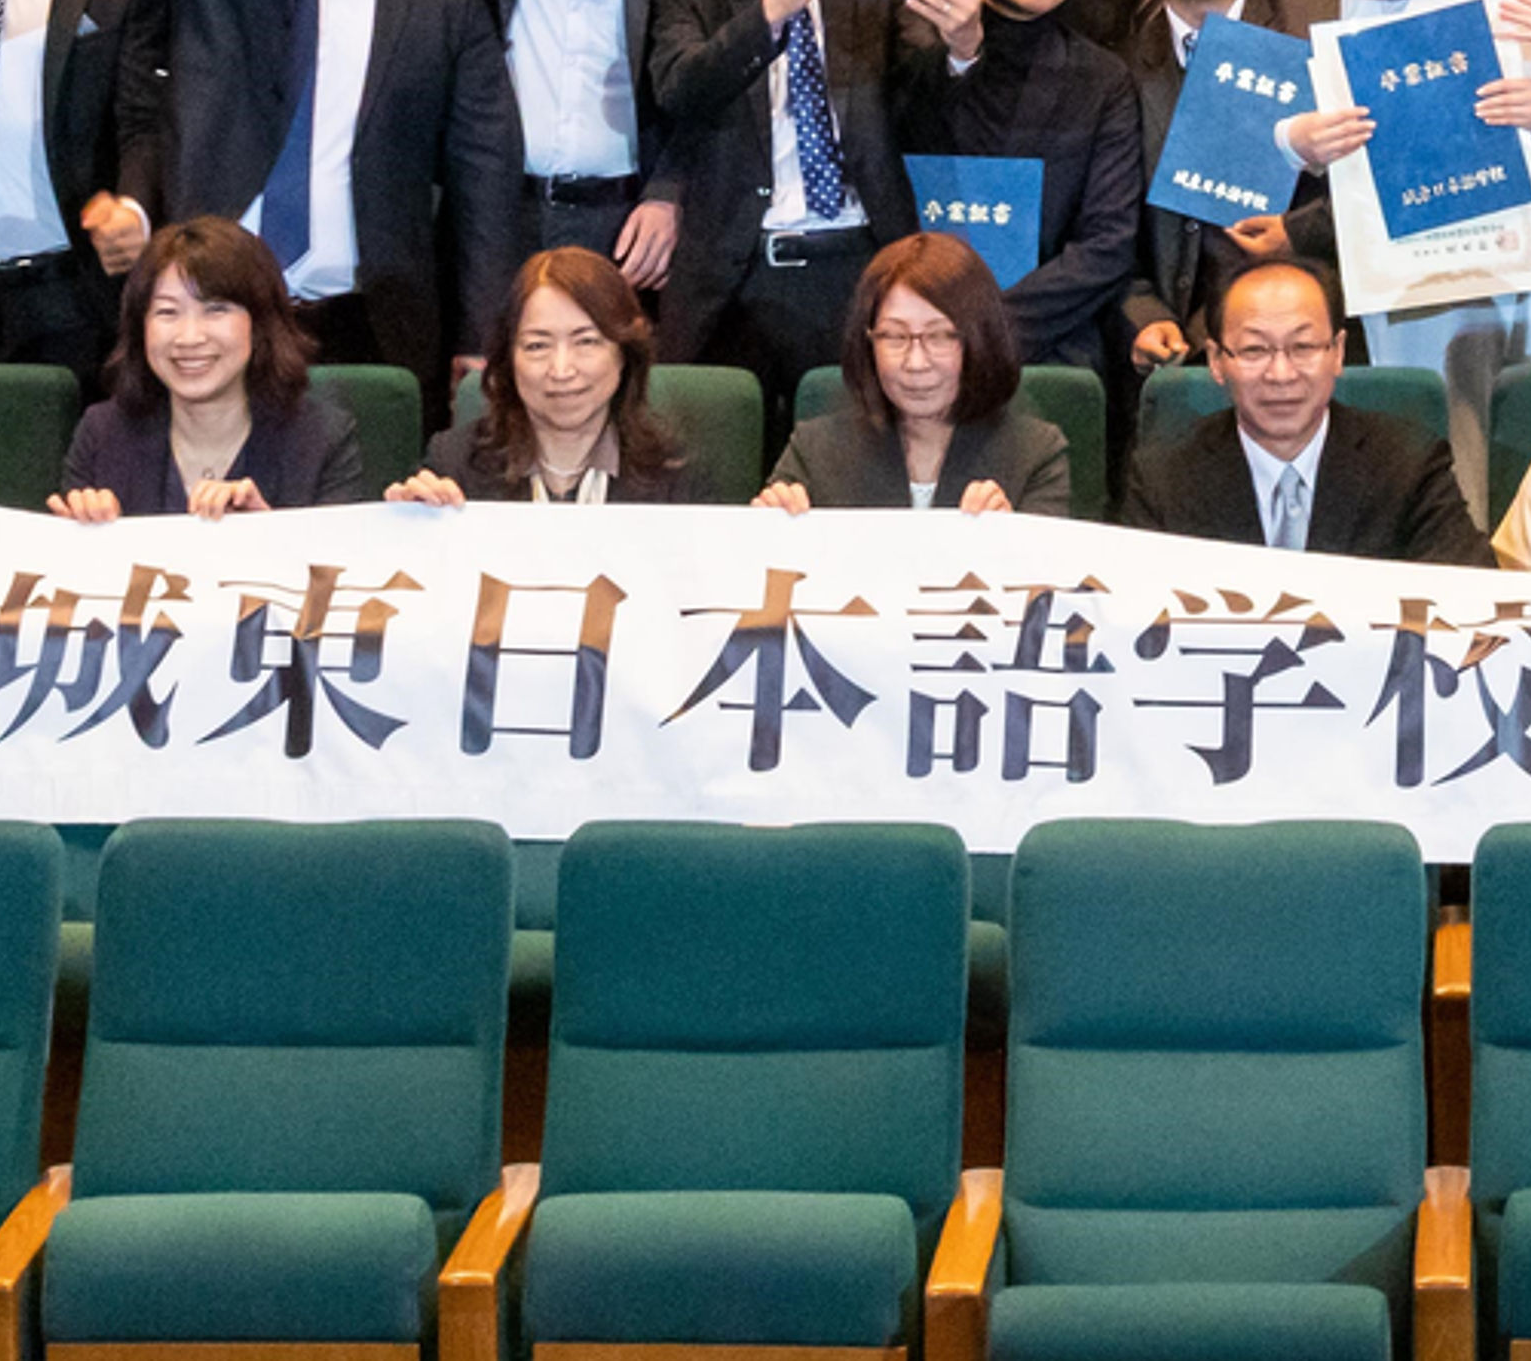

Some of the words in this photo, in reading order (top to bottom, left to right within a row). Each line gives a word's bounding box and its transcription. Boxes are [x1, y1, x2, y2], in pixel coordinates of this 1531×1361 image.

[1215, 62, 1297, 104] 卒業証書
[924, 200, 1012, 225] 卒業証書
